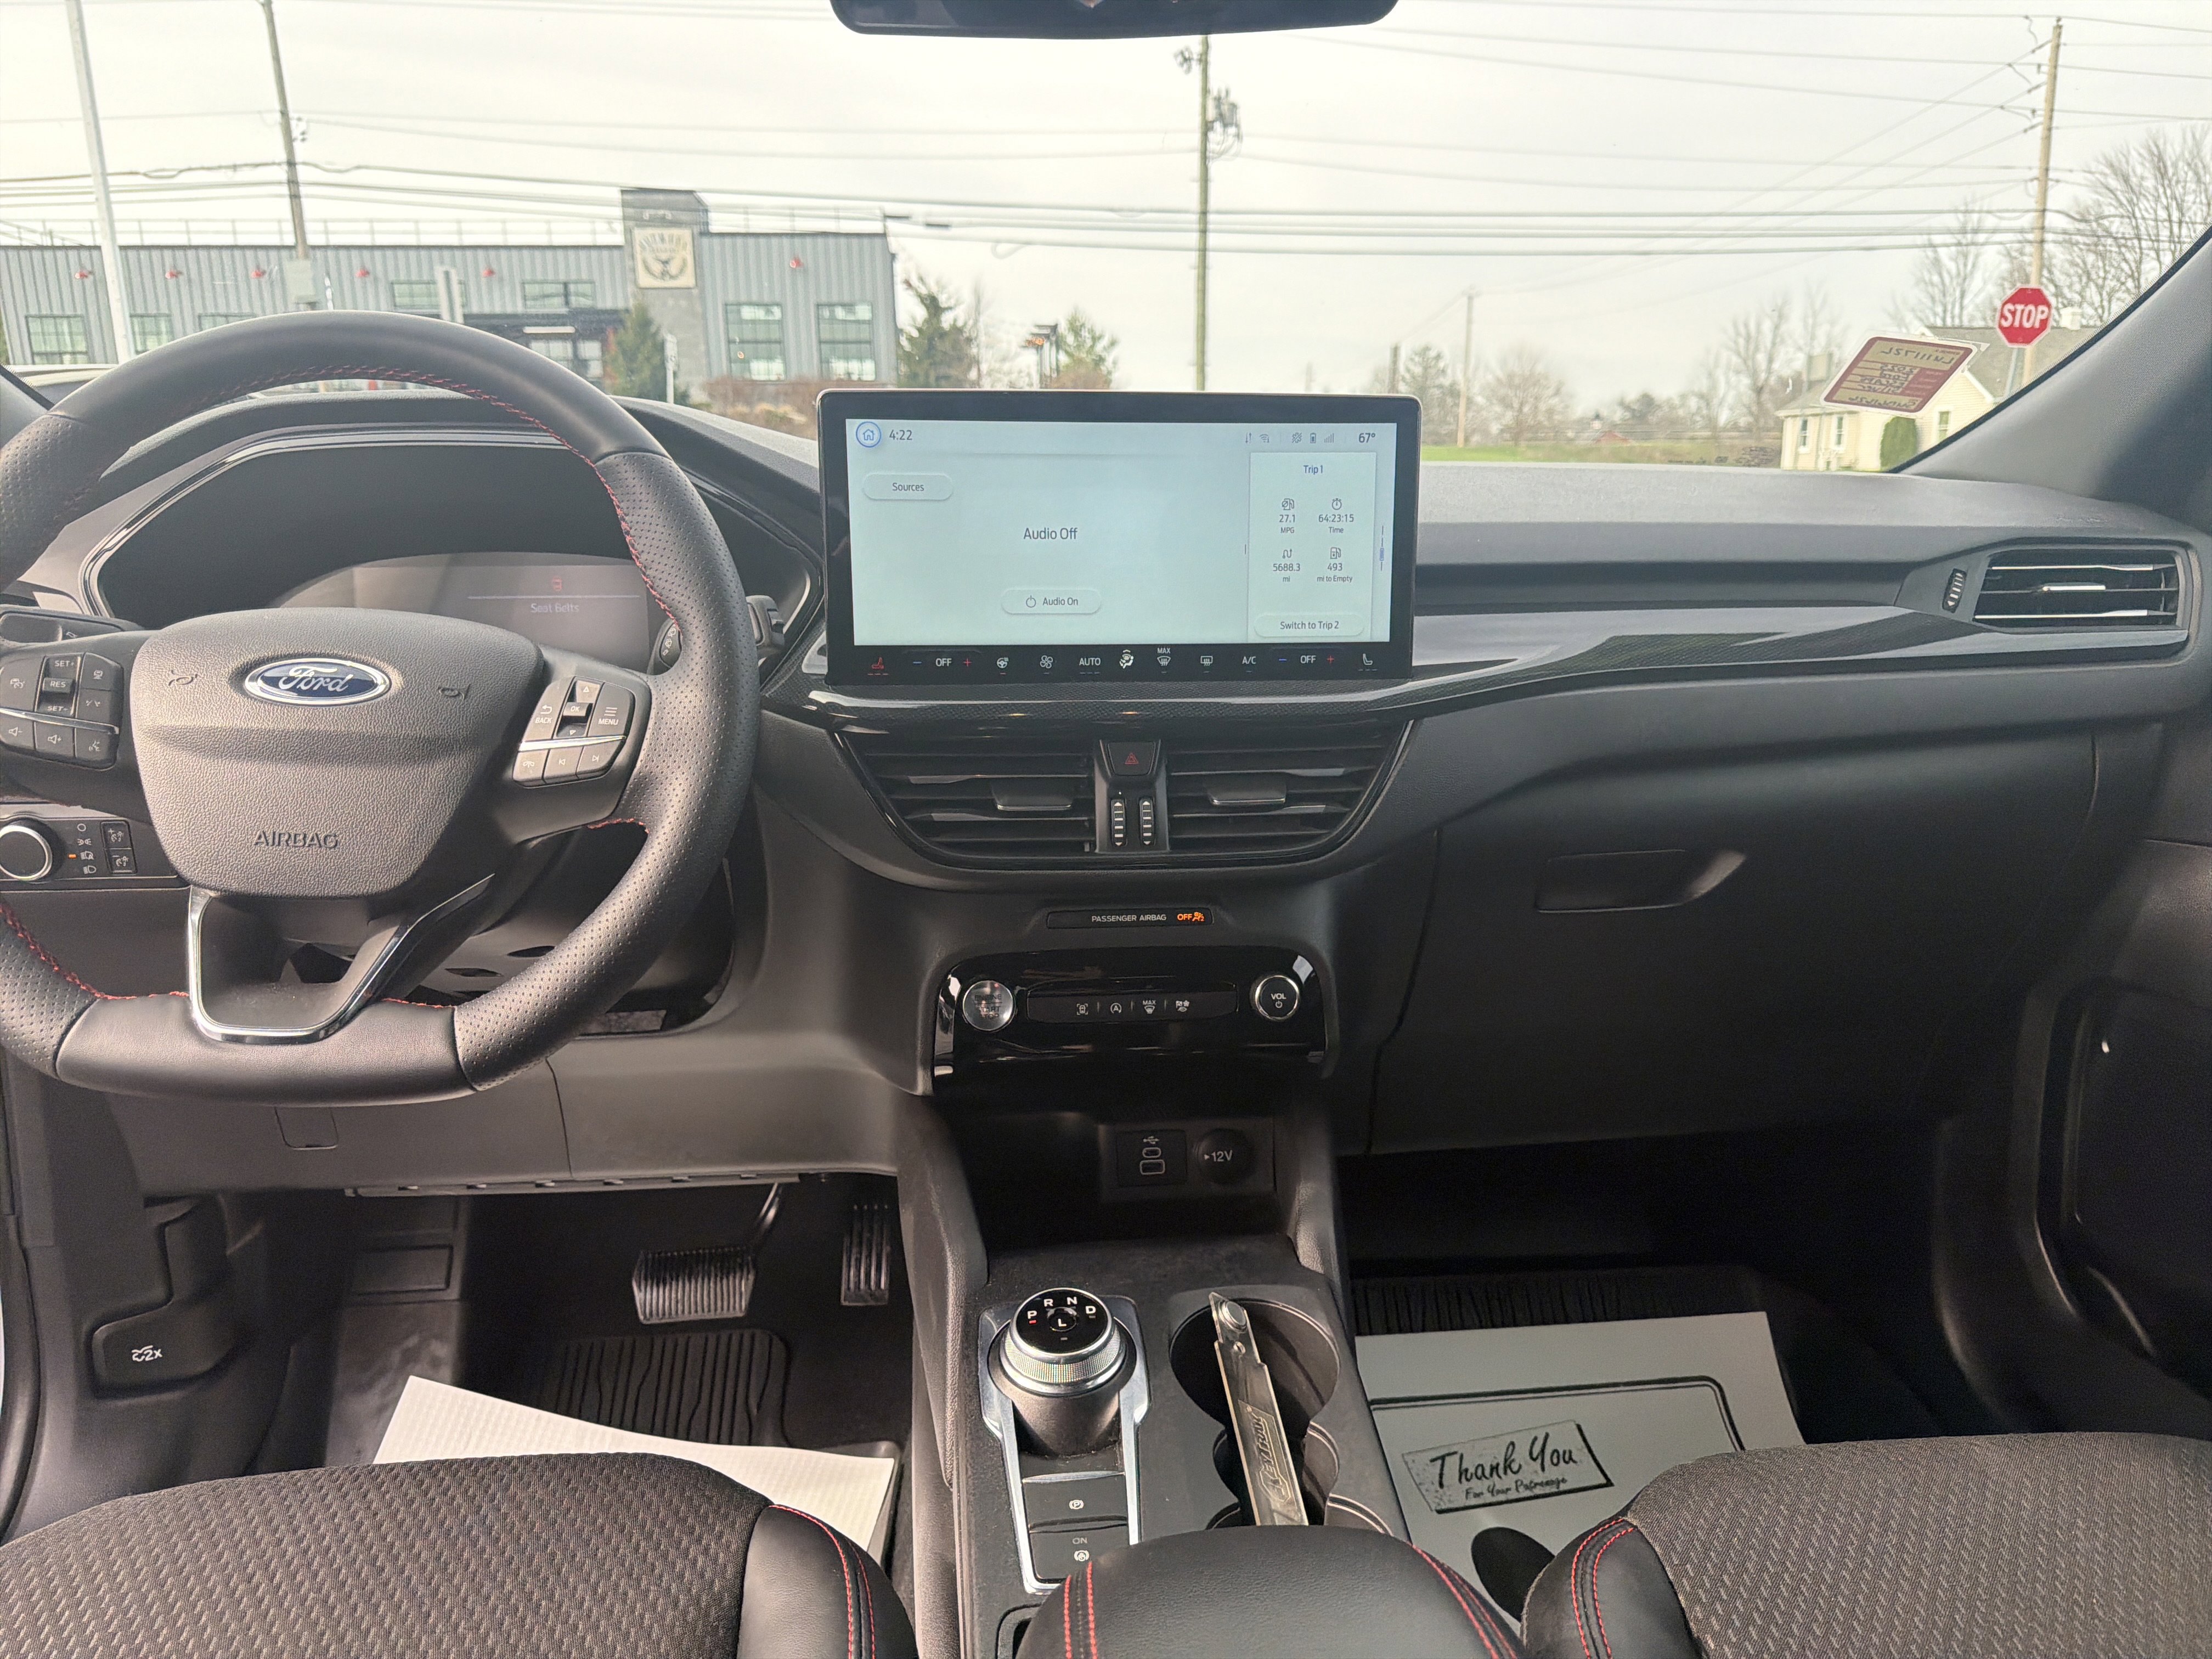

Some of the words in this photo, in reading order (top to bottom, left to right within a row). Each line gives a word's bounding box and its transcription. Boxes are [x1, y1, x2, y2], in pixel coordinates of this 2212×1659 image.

[2001, 303, 2049, 329] STOP
[889, 430, 912, 441] 4:22
[1303, 465, 1319, 475] Trip
[1320, 465, 1323, 473] 1
[892, 482, 924, 492] Sources
[1279, 514, 1295, 523] 27.1
[1318, 514, 1354, 522] 64:23:15
[1023, 527, 1057, 540] Audio
[1060, 527, 1078, 540] Off
[1273, 563, 1301, 572] 5688.3
[1327, 562, 1342, 571] 493
[1042, 597, 1065, 606] Audio
[1067, 597, 1079, 606] On
[1280, 621, 1306, 630] Switch
[1308, 622, 1316, 630] to
[1318, 621, 1333, 630] Trip
[1334, 620, 1339, 629] 2
[935, 658, 952, 667] OFF
[1079, 658, 1101, 667] AUTO
[1242, 656, 1256, 664] A/C
[1300, 655, 1316, 664] OFF
[278, 665, 354, 692] Ford
[253, 830, 338, 849] AIRBAG
[1211, 1149, 1233, 1162] 12V
[1027, 1310, 1037, 1319] P
[1043, 1299, 1054, 1307] R
[1066, 1296, 1077, 1305] N
[1085, 1306, 1096, 1314] D
[1058, 1318, 1067, 1327] L
[1429, 1441, 1522, 1489] Thank
[1528, 1431, 1578, 1473] You
[1465, 1487, 1484, 1500] For
[1487, 1481, 1512, 1497] Your
